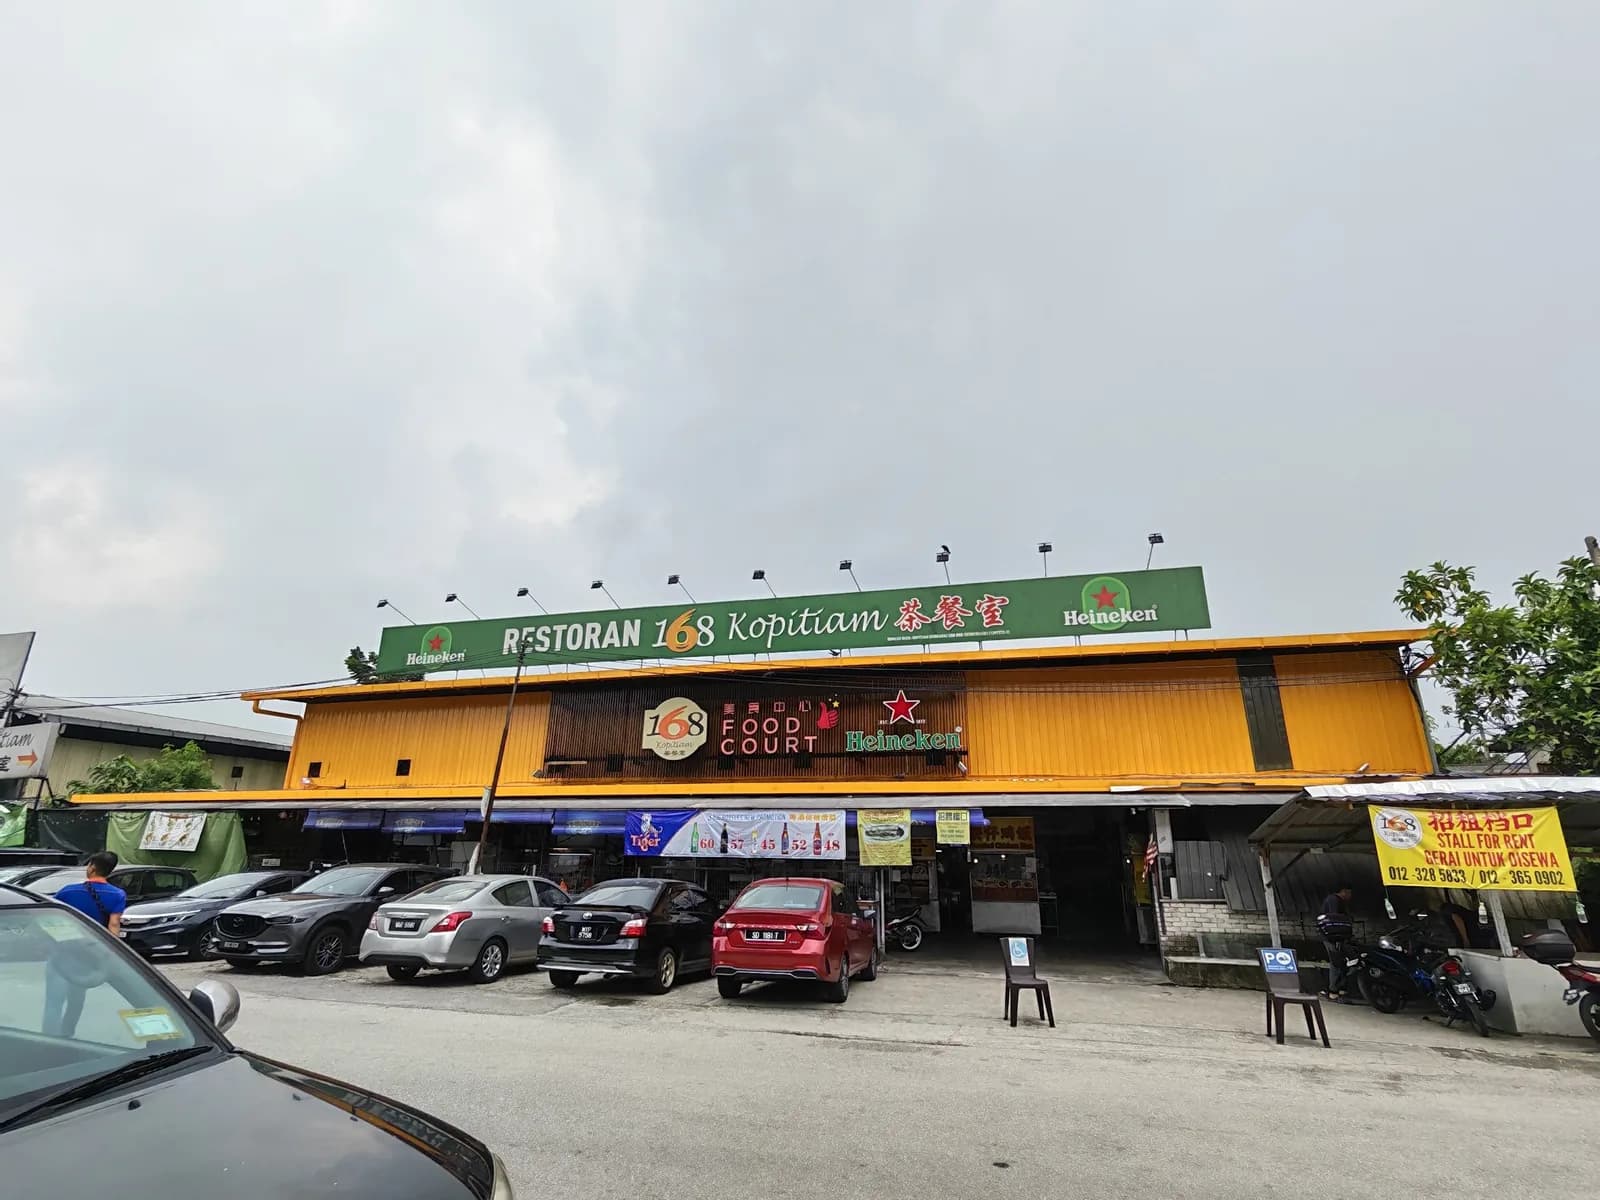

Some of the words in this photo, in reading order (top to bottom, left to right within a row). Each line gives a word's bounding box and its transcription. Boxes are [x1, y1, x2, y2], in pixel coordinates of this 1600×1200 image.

[894, 593, 1009, 632] 茶餐室
[1063, 607, 1158, 626] Heineken
[502, 619, 641, 655] RESTORAN
[651, 608, 715, 652] 168
[728, 607, 889, 649] Kopitiam
[406, 651, 465, 665] Heineken
[646, 704, 705, 740] 168
[722, 717, 801, 736] FOOD
[721, 736, 818, 755] COURT
[845, 729, 961, 752] Heineken
[631, 834, 661, 852] Tiger
[700, 839, 715, 849] 60
[730, 839, 745, 850] 57
[761, 839, 776, 850] 45
[791, 839, 807, 850] 52
[824, 840, 840, 850] 48
[1437, 832, 1475, 849] STALL
[1476, 833, 1501, 849] FOR
[1503, 833, 1535, 849] RENT
[1424, 849, 1460, 866] GERAI
[1463, 851, 1506, 867] UNTUK
[1508, 851, 1559, 868] DISEWA
[1388, 866, 1408, 881] 012
[1480, 870, 1499, 884] 012
[1509, 870, 1532, 885] 365
[1534, 870, 1565, 885] 0902
[1265, 952, 1275, 964] P
